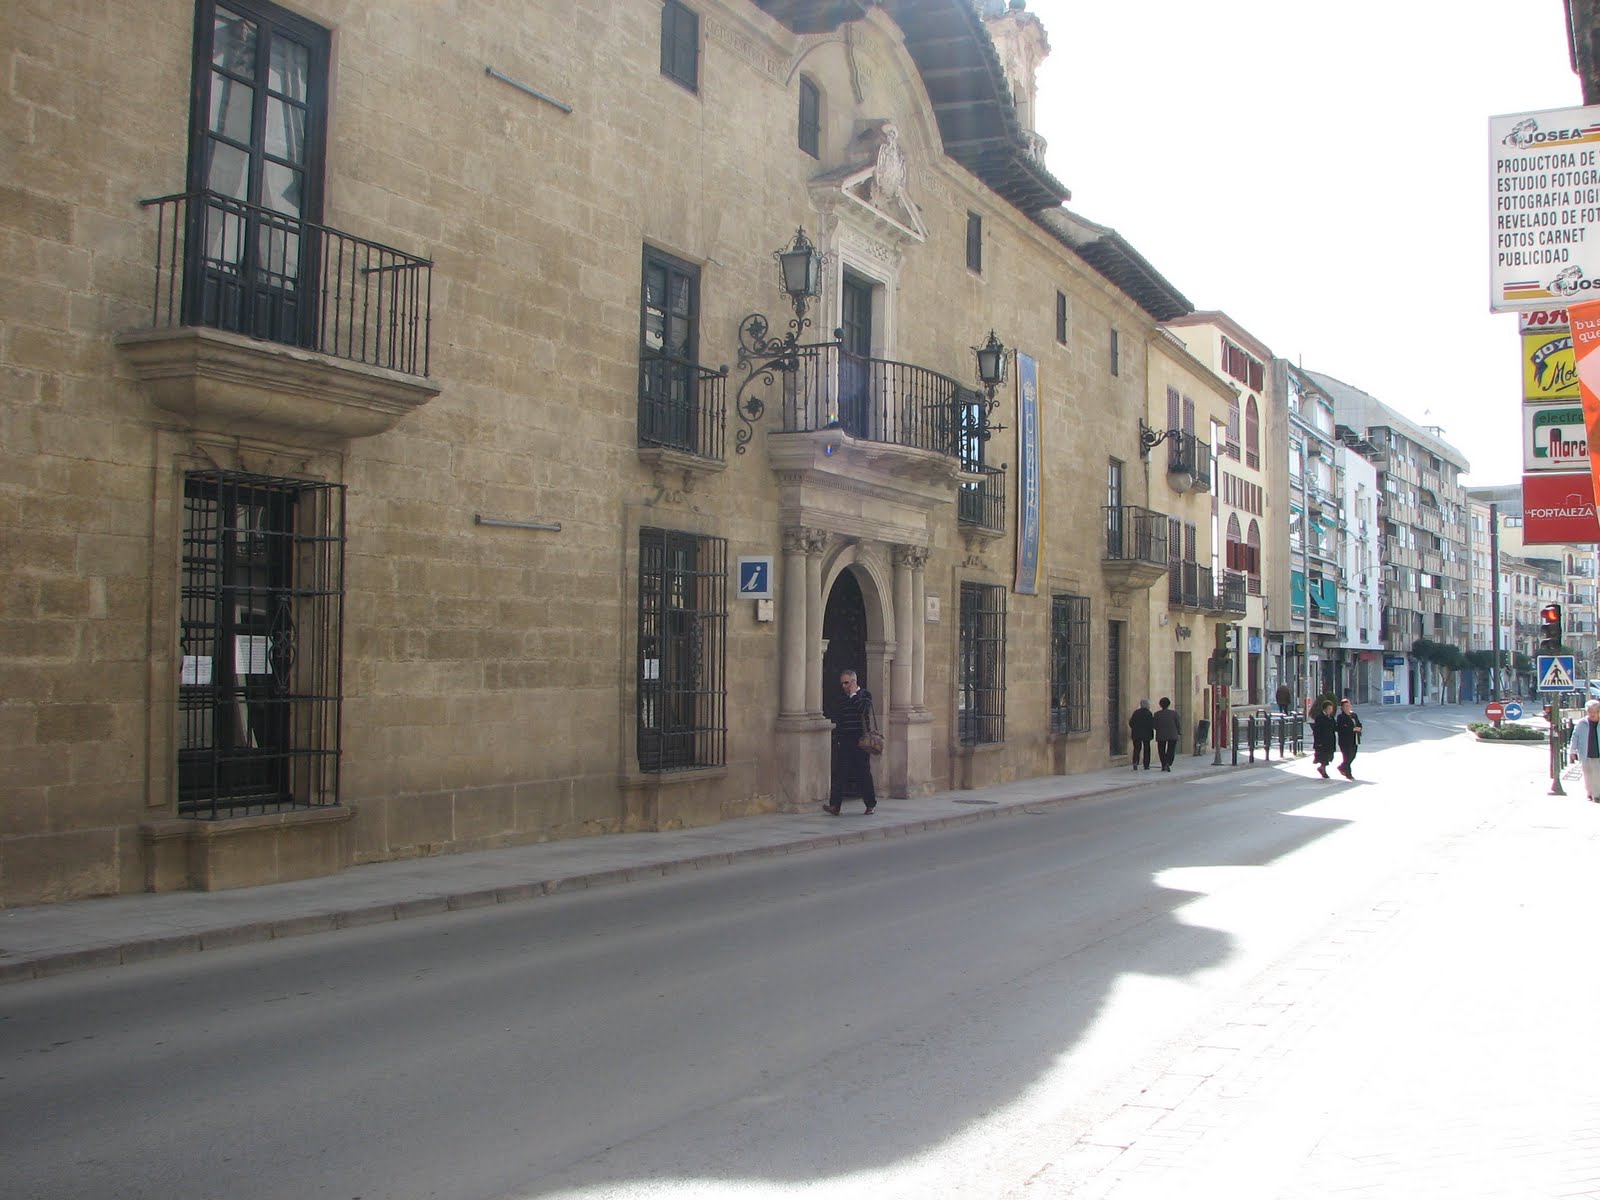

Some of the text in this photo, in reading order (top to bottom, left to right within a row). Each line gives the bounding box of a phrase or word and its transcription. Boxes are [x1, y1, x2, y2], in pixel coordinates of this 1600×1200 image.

[1524, 128, 1582, 144] JOSEA
[1497, 151, 1595, 174] PRODUCTORA DE
[1497, 174, 1547, 193] ESTUDIO
[1497, 188, 1600, 211] FOTOGRAFIA DIGI
[1498, 211, 1557, 230] REVELADO
[1562, 209, 1577, 225] DE
[1498, 227, 1585, 248] FOTOS CARNET
[1498, 248, 1569, 267] PUBLICIDAD
[1531, 507, 1594, 518] FORTALEZA
